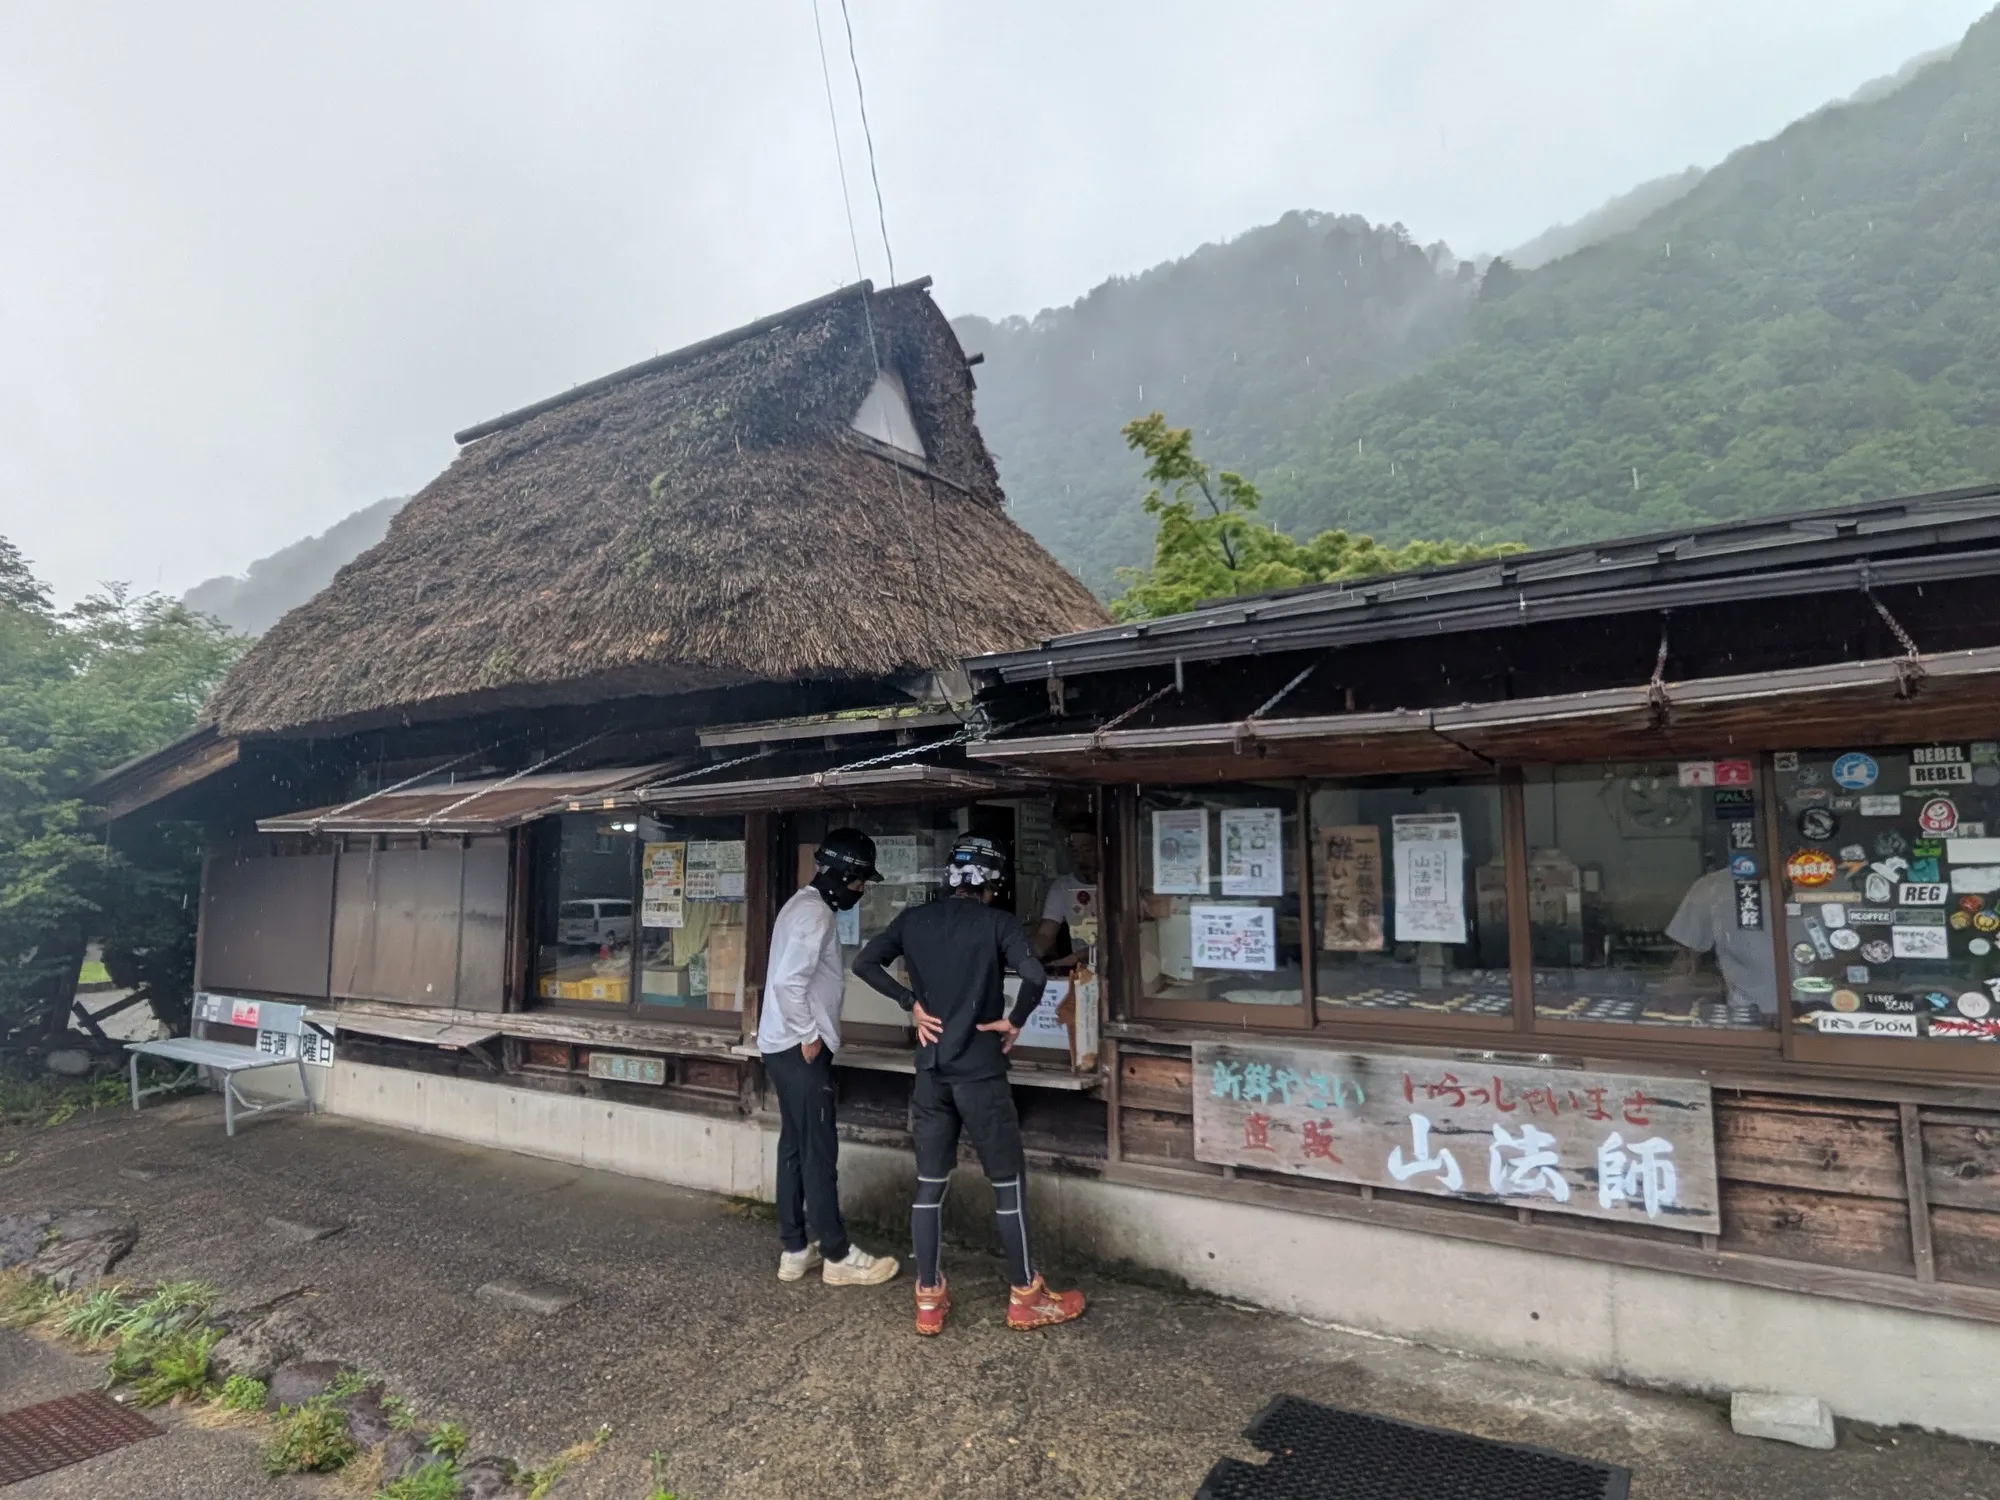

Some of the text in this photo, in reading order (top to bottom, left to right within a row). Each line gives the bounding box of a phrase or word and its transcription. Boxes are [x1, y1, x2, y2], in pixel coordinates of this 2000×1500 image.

[1913, 747, 1964, 763] REBEL
[1915, 766, 1966, 782] REBEL
[1905, 886, 1940, 901] REG
[1210, 1060, 1366, 1109] 新鮮やさい
[1403, 1071, 1652, 1127] いらっしゃいませ
[1240, 1111, 1343, 1165] 直販
[1386, 1113, 1679, 1220] 山法師
